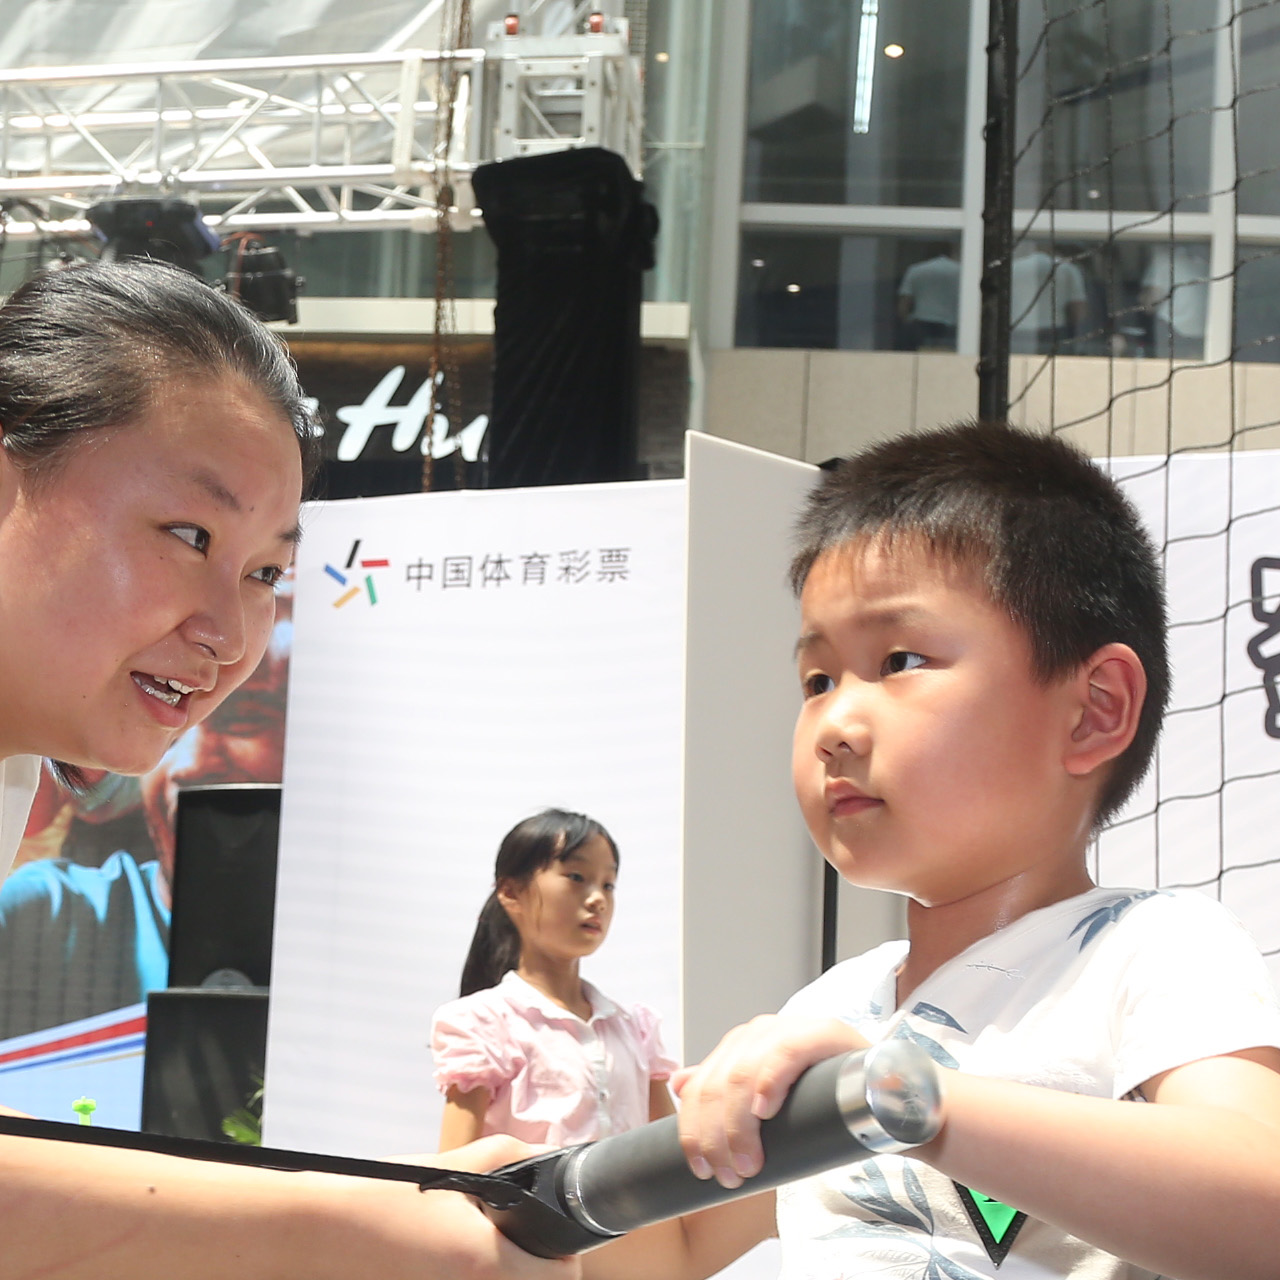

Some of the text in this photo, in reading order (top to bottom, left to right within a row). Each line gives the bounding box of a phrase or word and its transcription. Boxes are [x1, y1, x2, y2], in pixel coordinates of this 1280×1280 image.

[336, 364, 490, 463] Hu
[405, 547, 631, 592] 中国体育彩票
